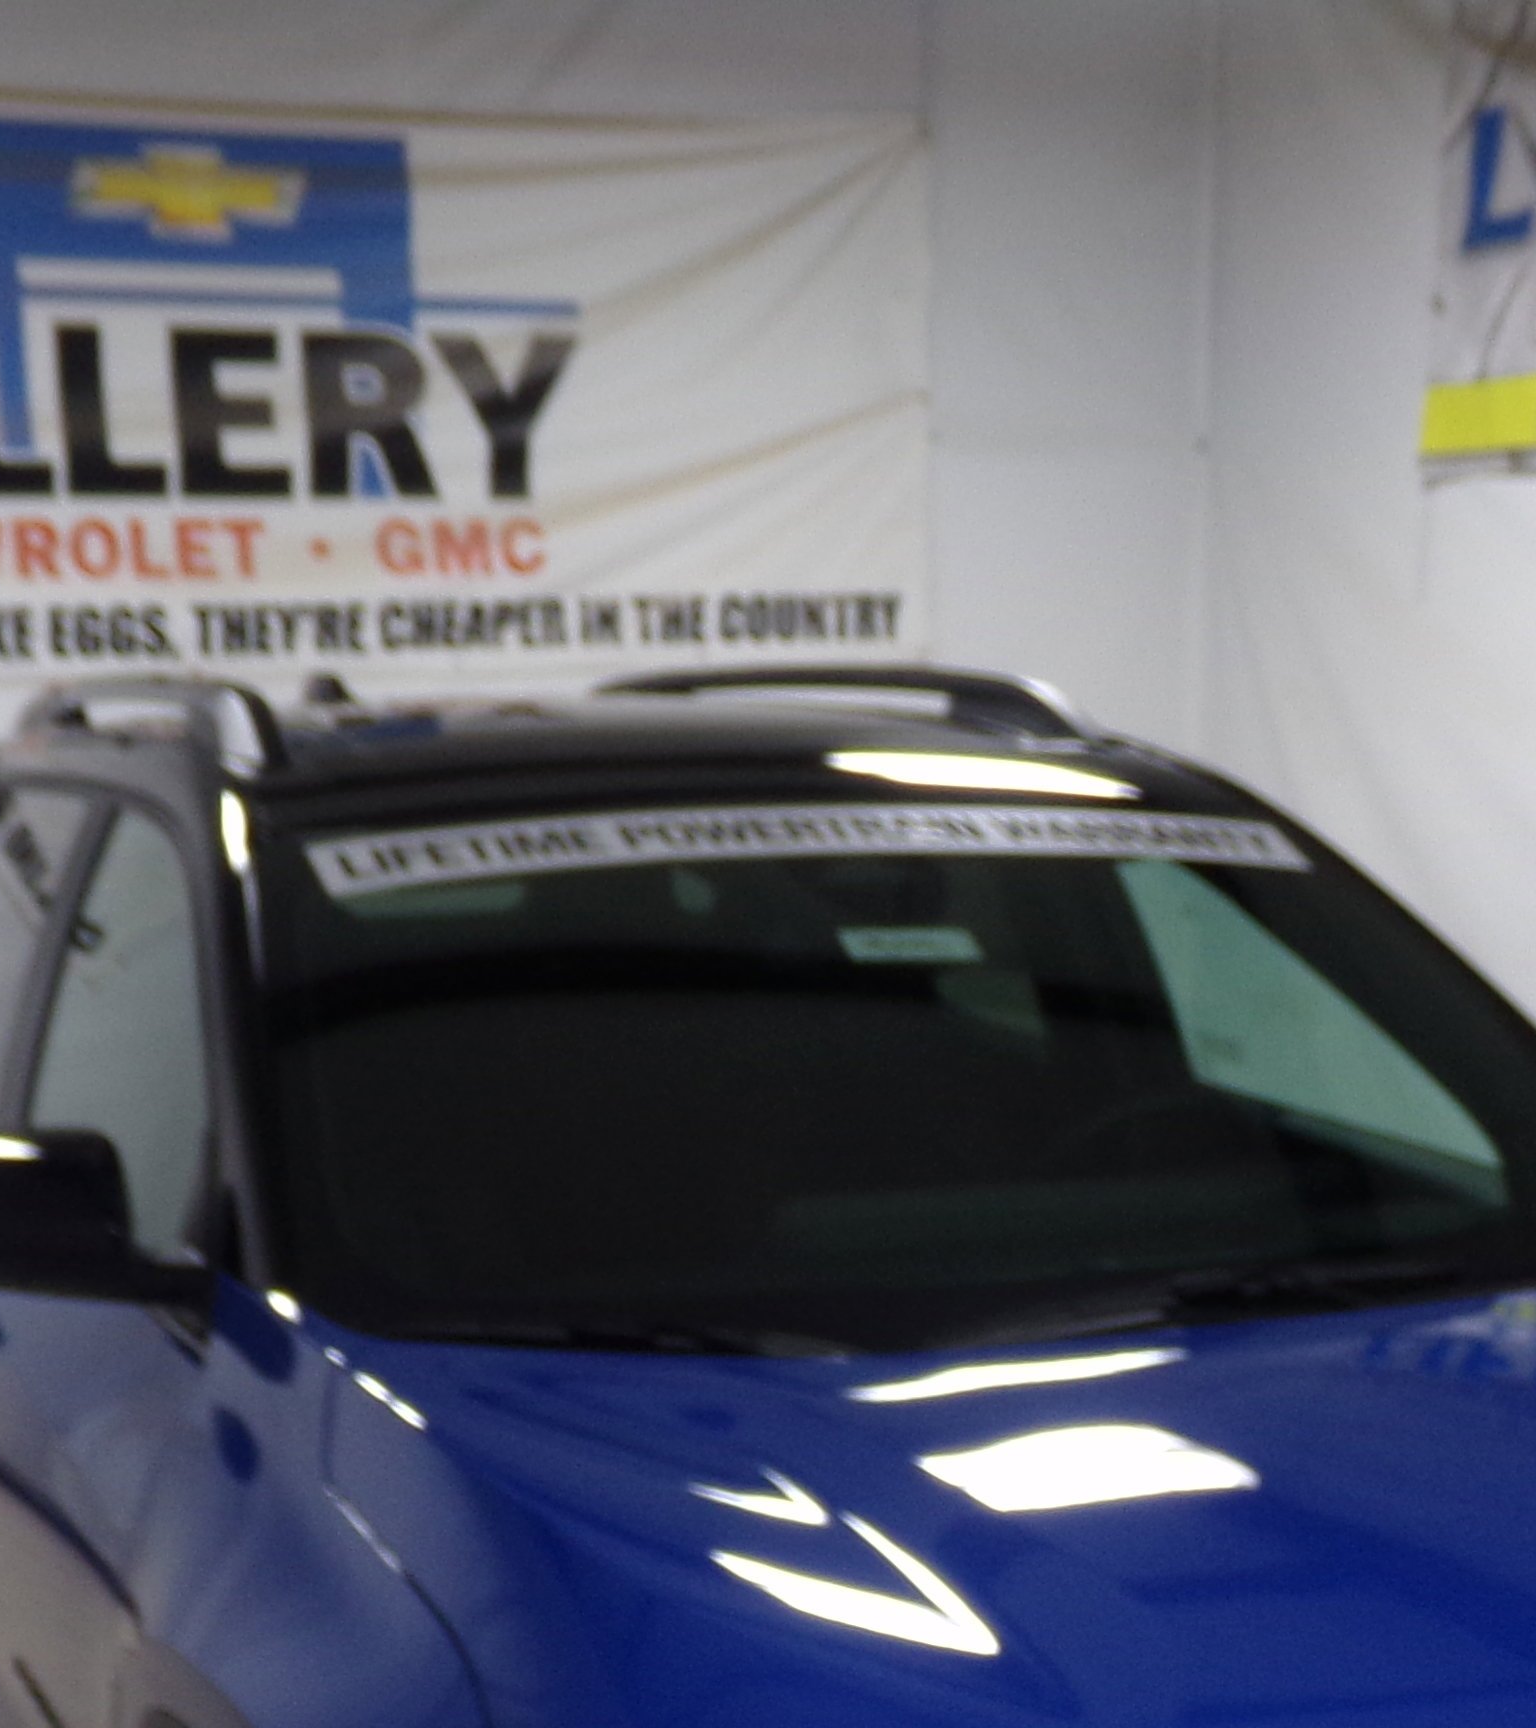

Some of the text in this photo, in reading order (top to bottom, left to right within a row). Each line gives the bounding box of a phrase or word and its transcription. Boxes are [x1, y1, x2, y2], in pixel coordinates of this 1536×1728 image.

[375, 516, 547, 577] GMC
[379, 600, 566, 649] CHEAPER
[576, 598, 620, 646] IN
[629, 596, 705, 645] THE
[716, 594, 901, 644] COUNTRY
